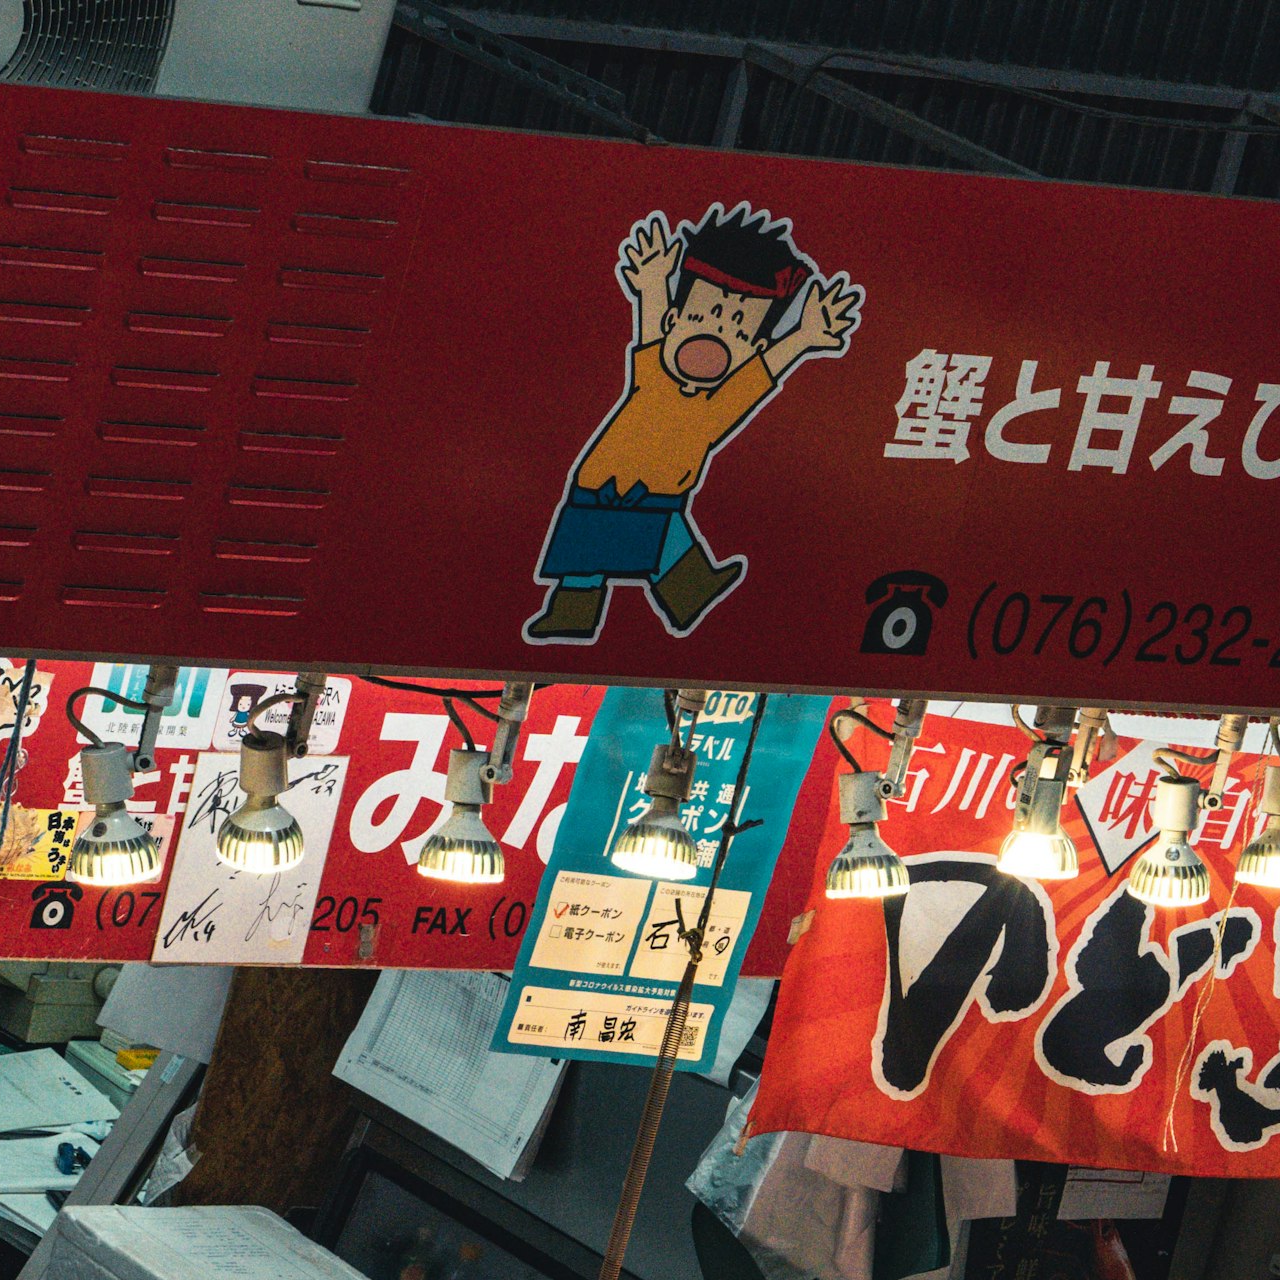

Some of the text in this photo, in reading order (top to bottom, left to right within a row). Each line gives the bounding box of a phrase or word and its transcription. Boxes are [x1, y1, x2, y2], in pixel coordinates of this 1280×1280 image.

[569, 904, 623, 919] 紙クーポン
[411, 906, 473, 935] FAX
[563, 926, 625, 943] 電子クーポン
